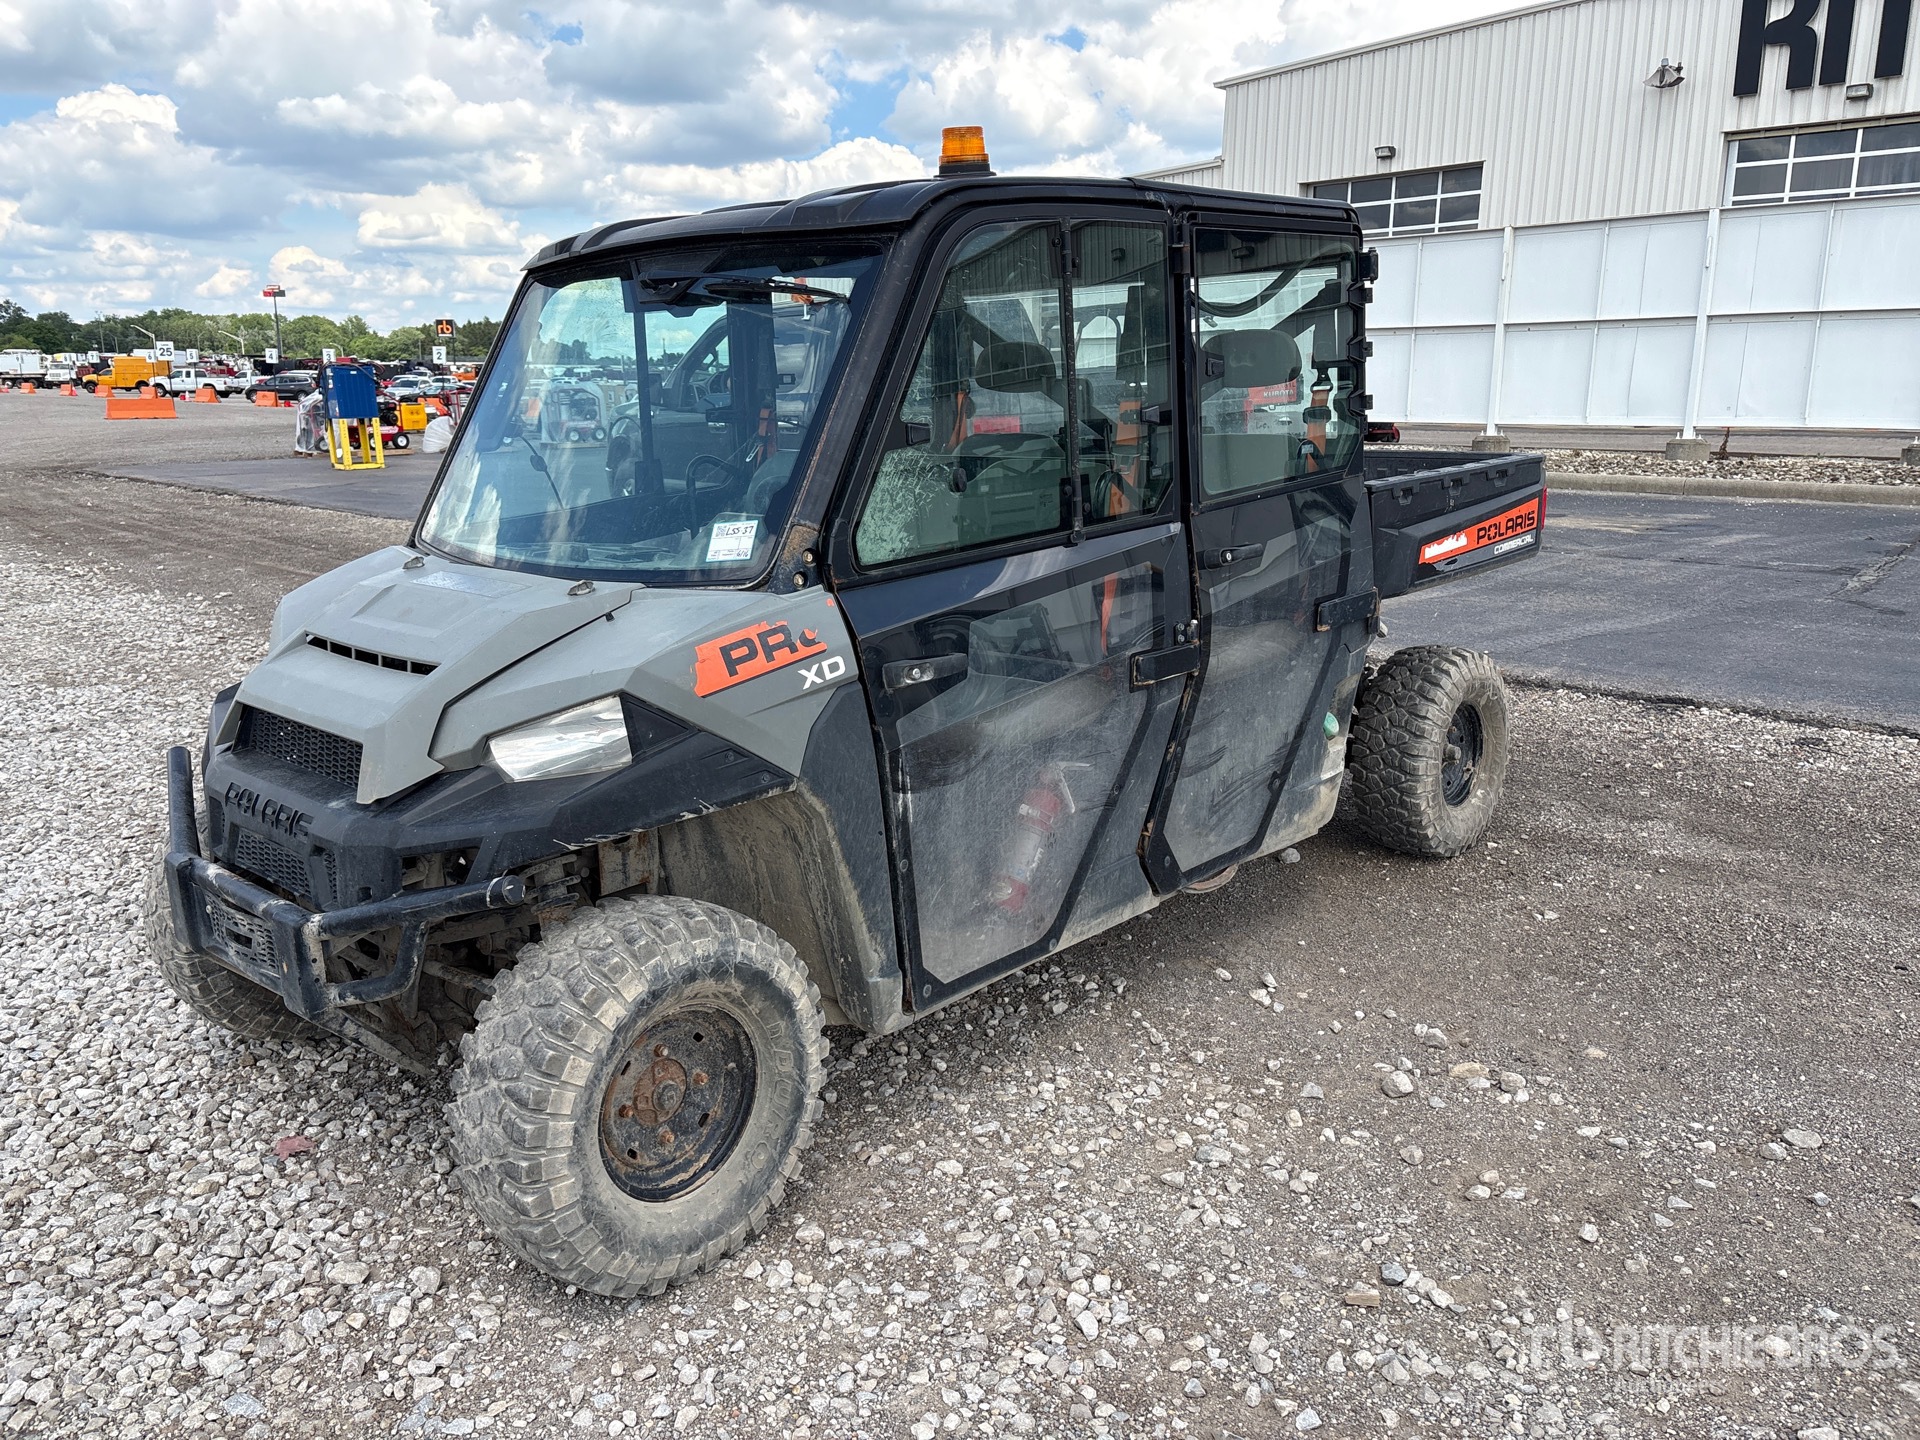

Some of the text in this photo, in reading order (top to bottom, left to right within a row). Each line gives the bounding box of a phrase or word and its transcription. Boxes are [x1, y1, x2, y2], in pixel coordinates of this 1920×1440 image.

[158, 347, 173, 357] 25
[189, 352, 194, 360] 5
[268, 352, 274, 361] 4
[436, 351, 443, 360] 2
[1263, 389, 1294, 398] KUBOTA
[1476, 510, 1536, 544] POLARIS
[797, 655, 847, 690] XD
[225, 782, 315, 839] POLARIS
